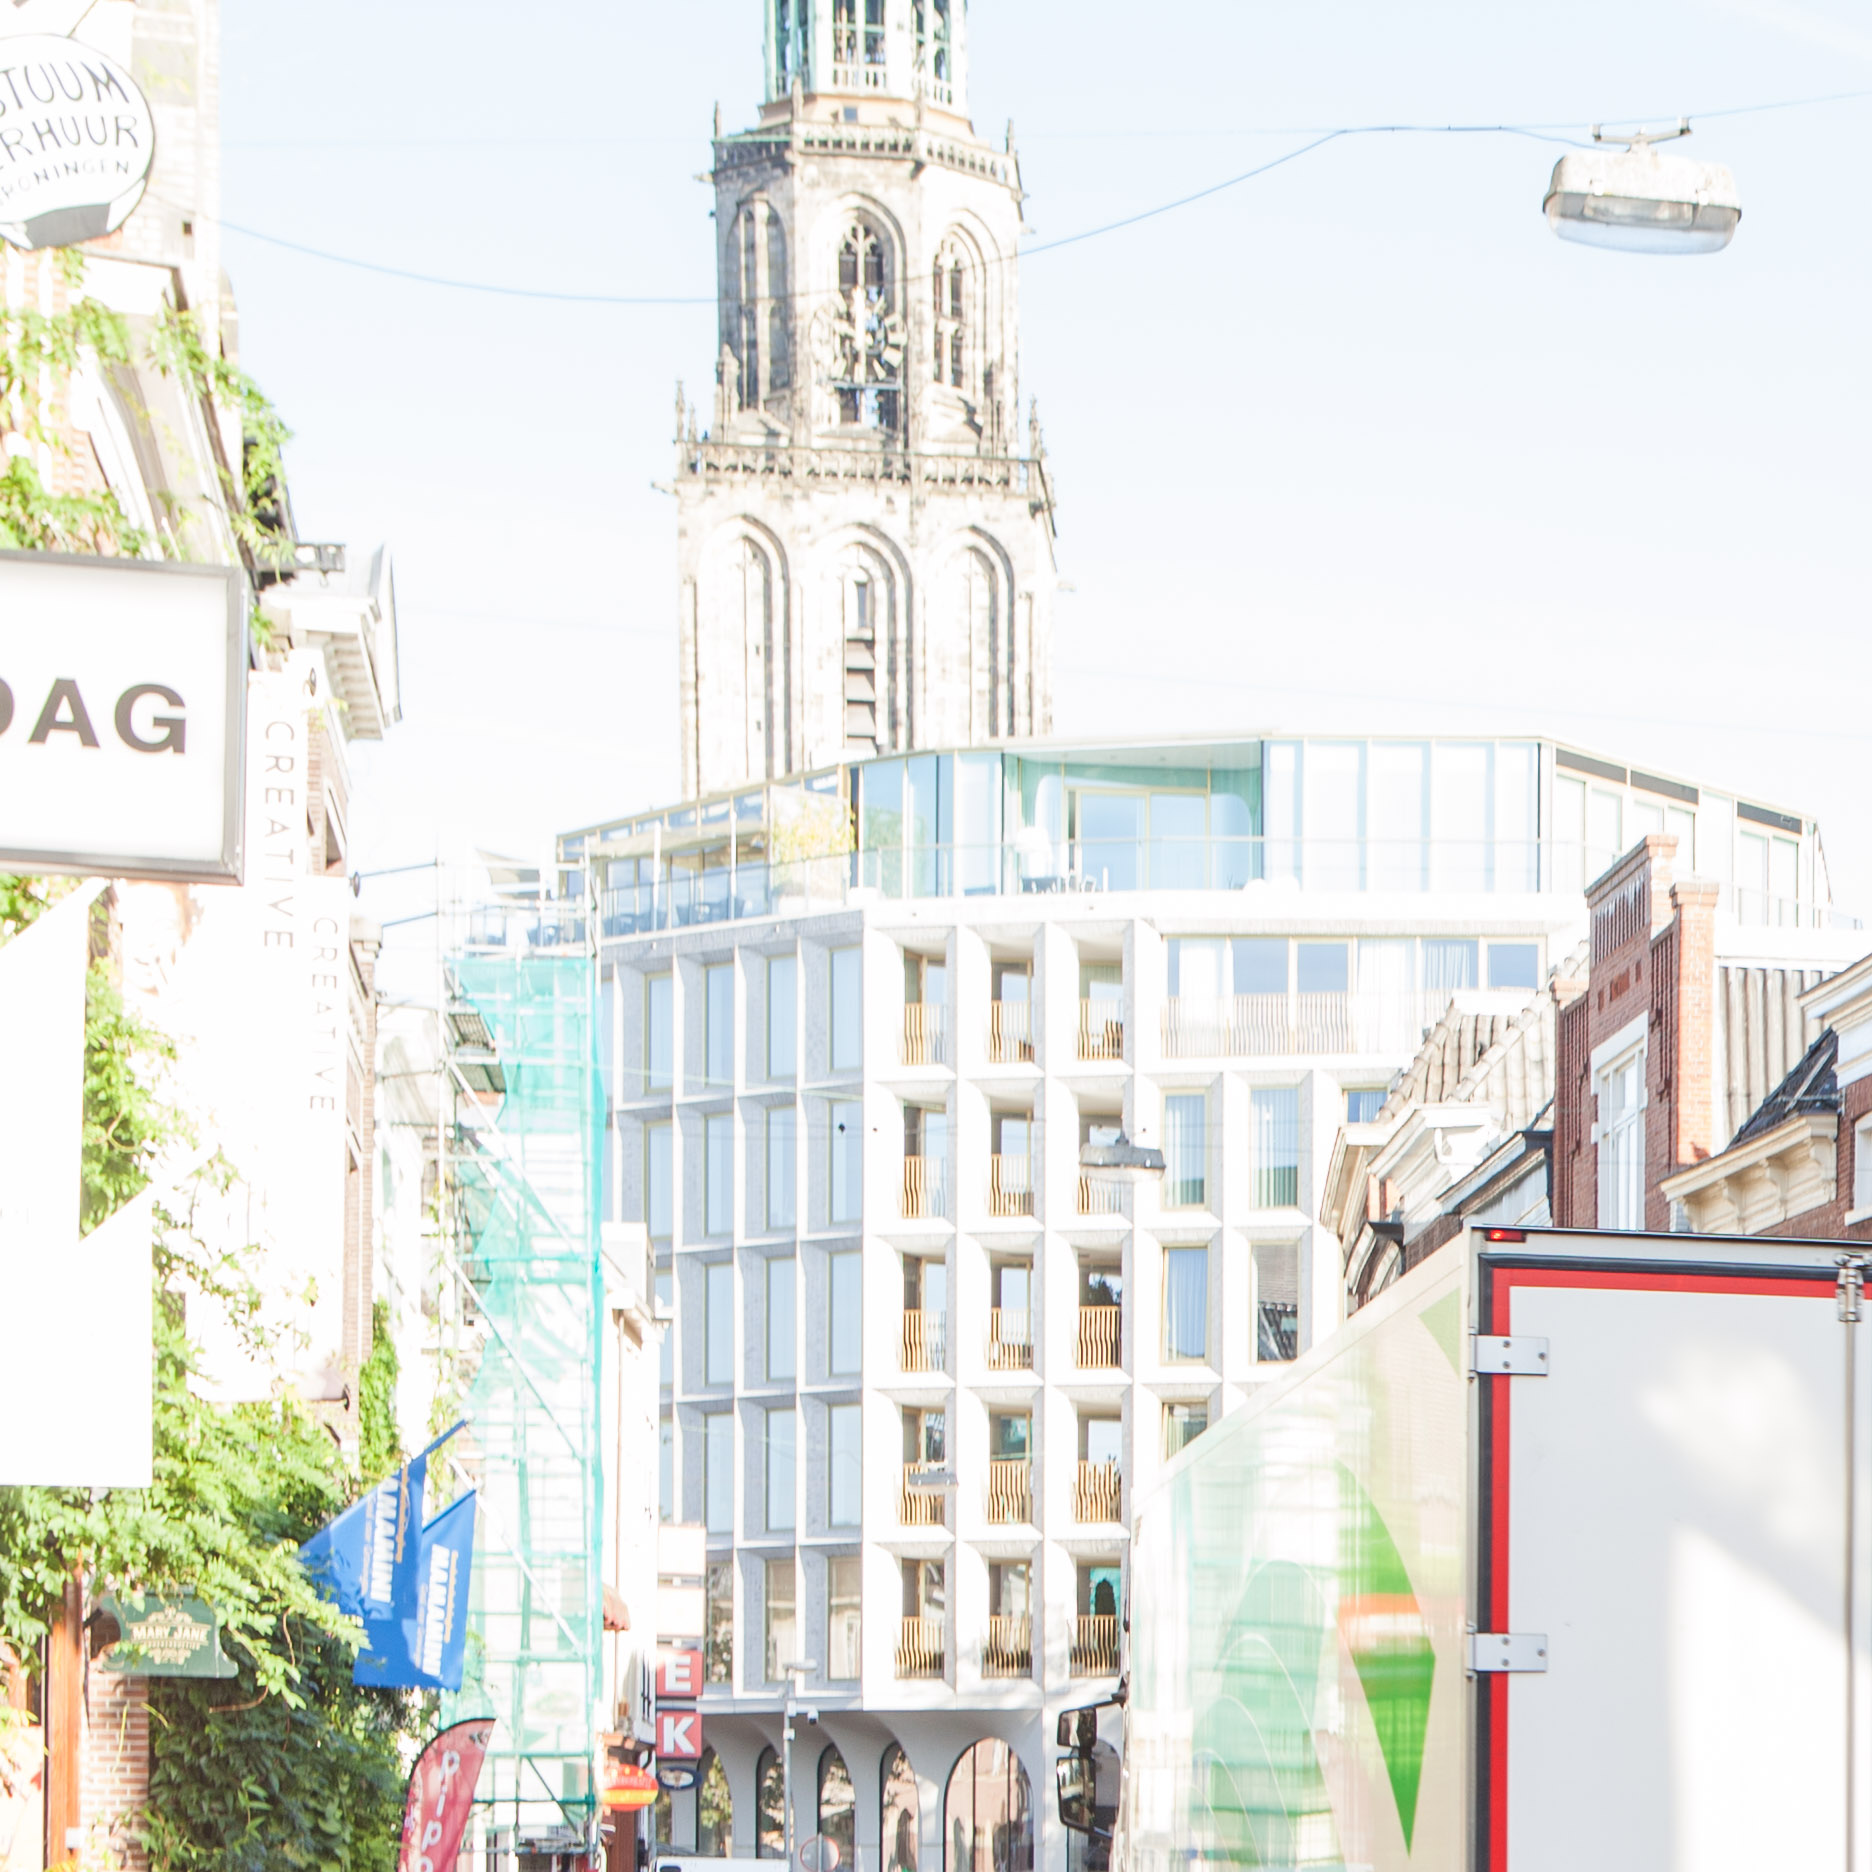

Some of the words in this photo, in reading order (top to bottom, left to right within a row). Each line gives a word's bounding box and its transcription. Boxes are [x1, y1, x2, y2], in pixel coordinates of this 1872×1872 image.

[0, 60, 130, 117] TUUM
[0, 115, 139, 162] RHUUR
[0, 160, 129, 199] RONINGEN
[264, 720, 295, 949] CREATIVE
[310, 916, 338, 1113] CREATIVE
[131, 1624, 171, 1640] MARY
